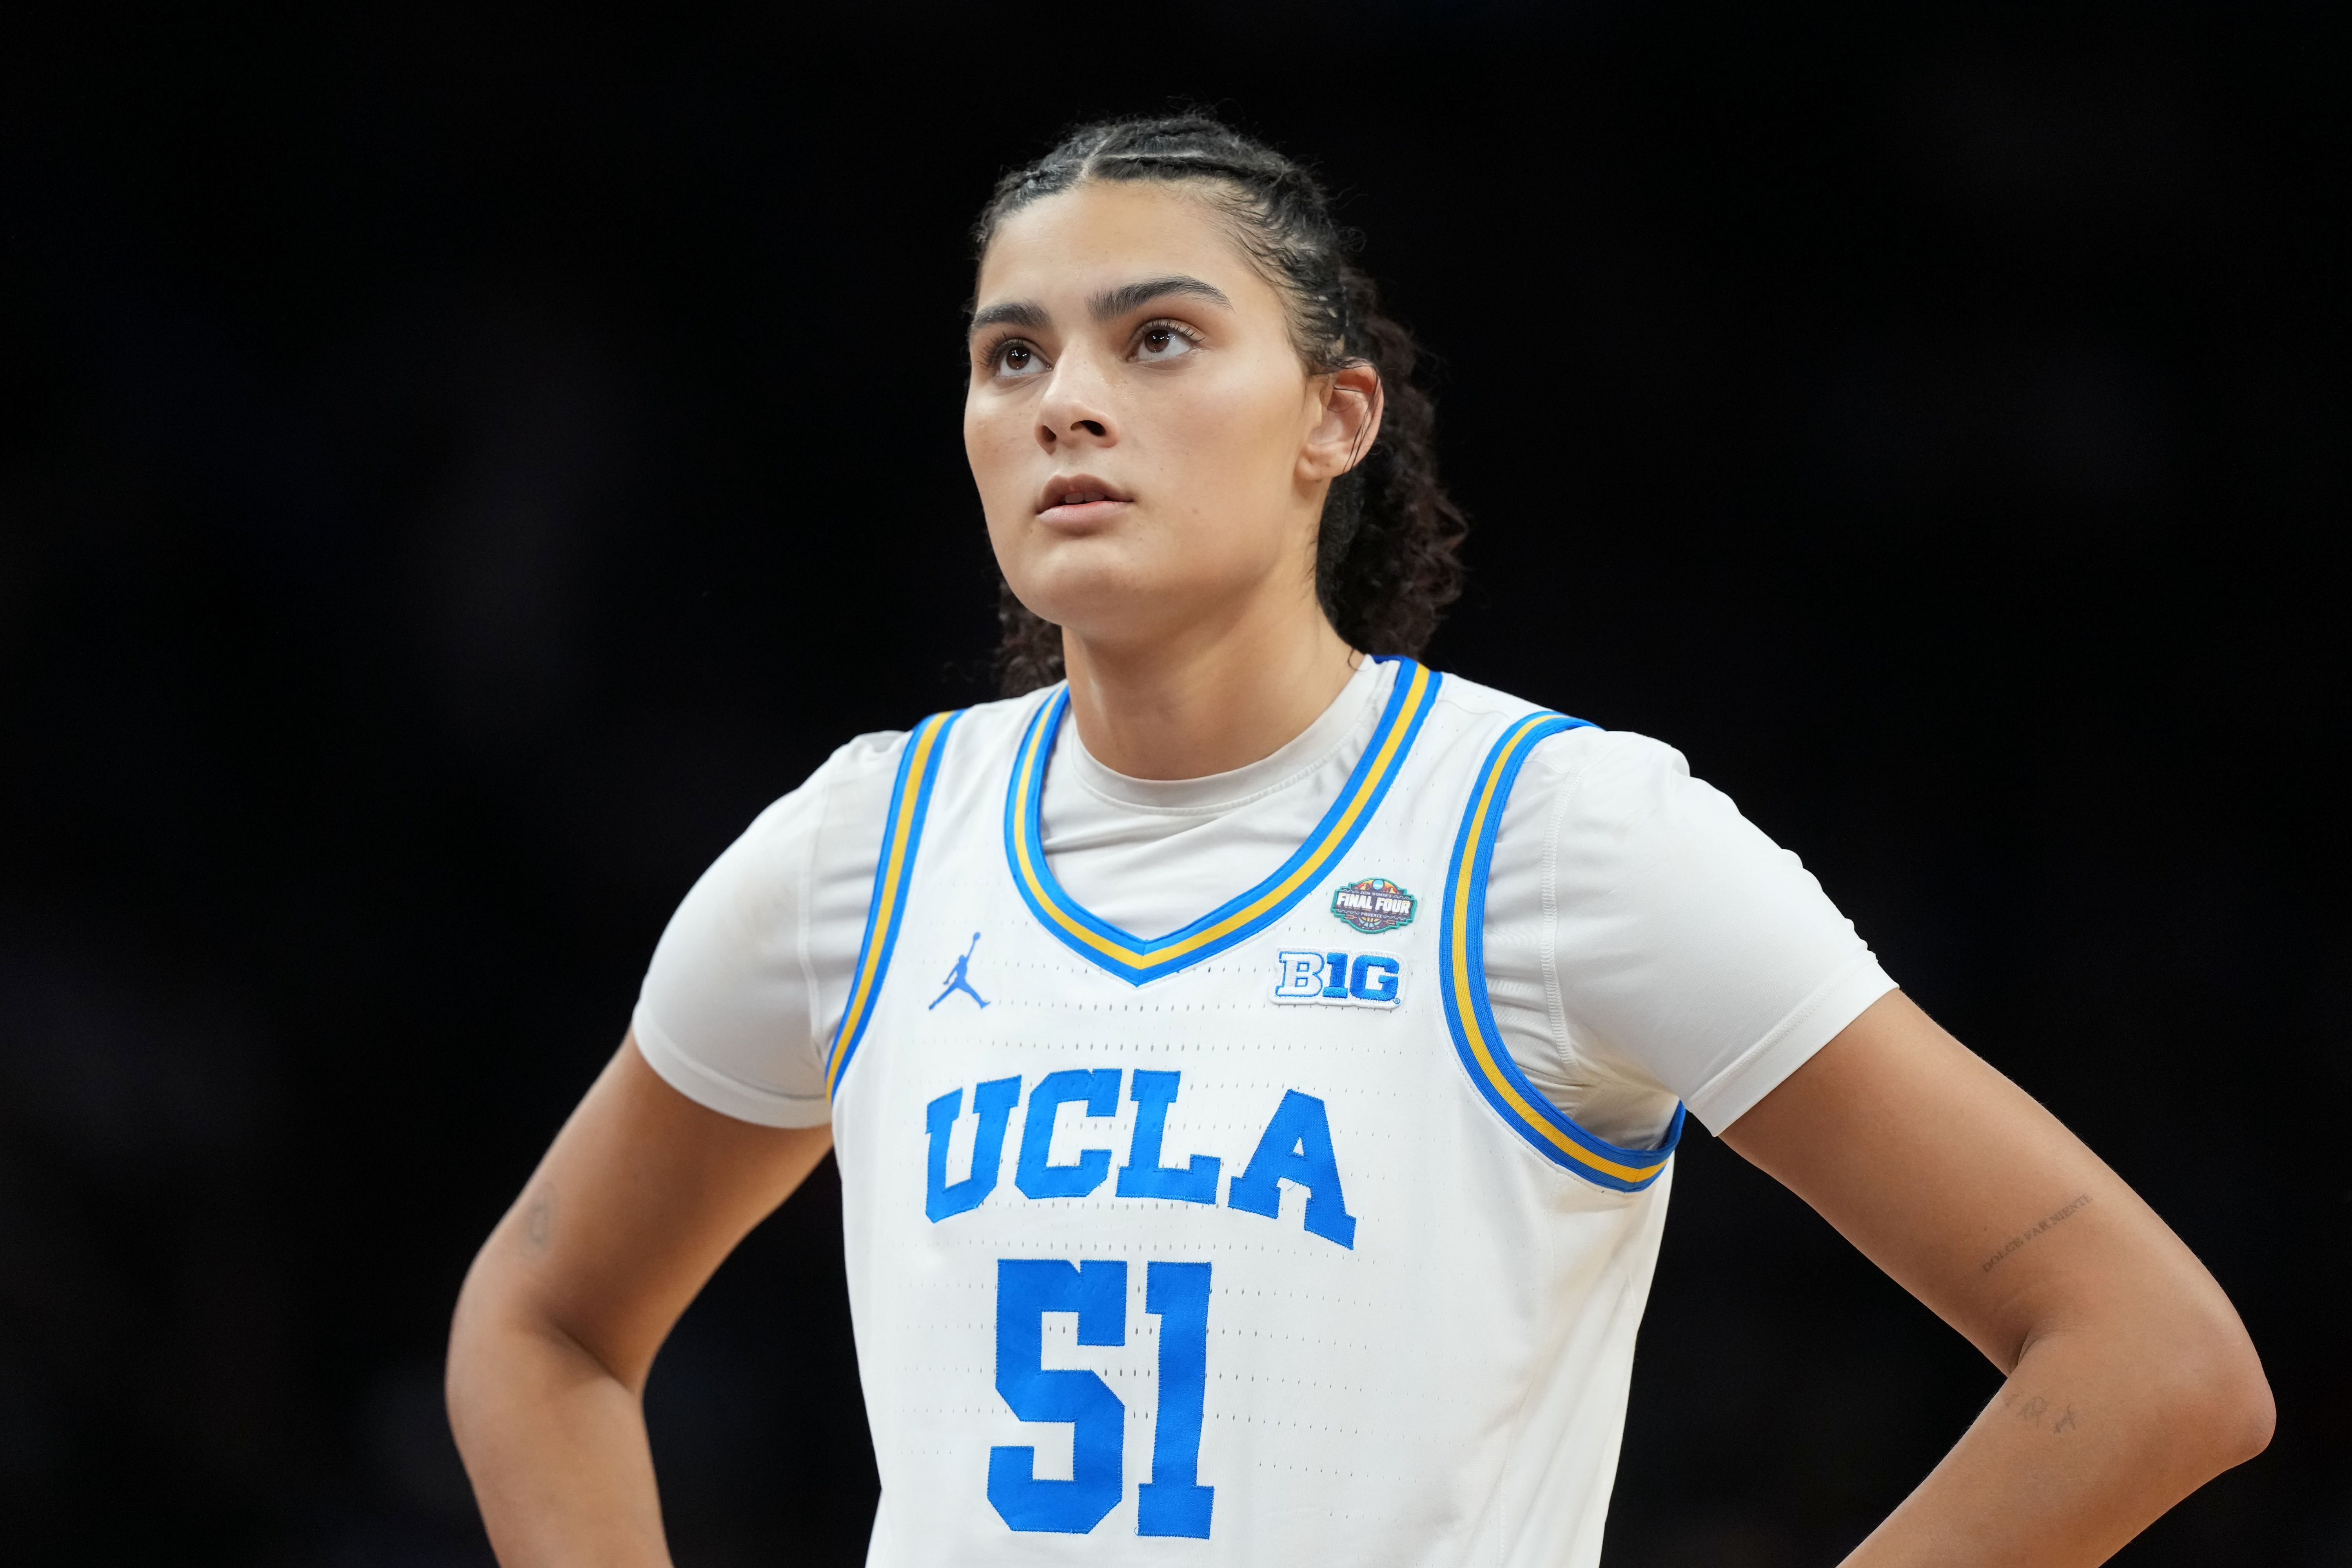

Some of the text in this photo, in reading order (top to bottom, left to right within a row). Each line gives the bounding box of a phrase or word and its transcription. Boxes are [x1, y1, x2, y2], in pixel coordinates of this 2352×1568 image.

[1336, 892, 1411, 914] FINAL FOUR
[925, 1069, 1356, 1250] UCLA
[1983, 1194, 2093, 1272] DOLCE FAR NIENTE
[987, 1258, 1214, 1539] 51
